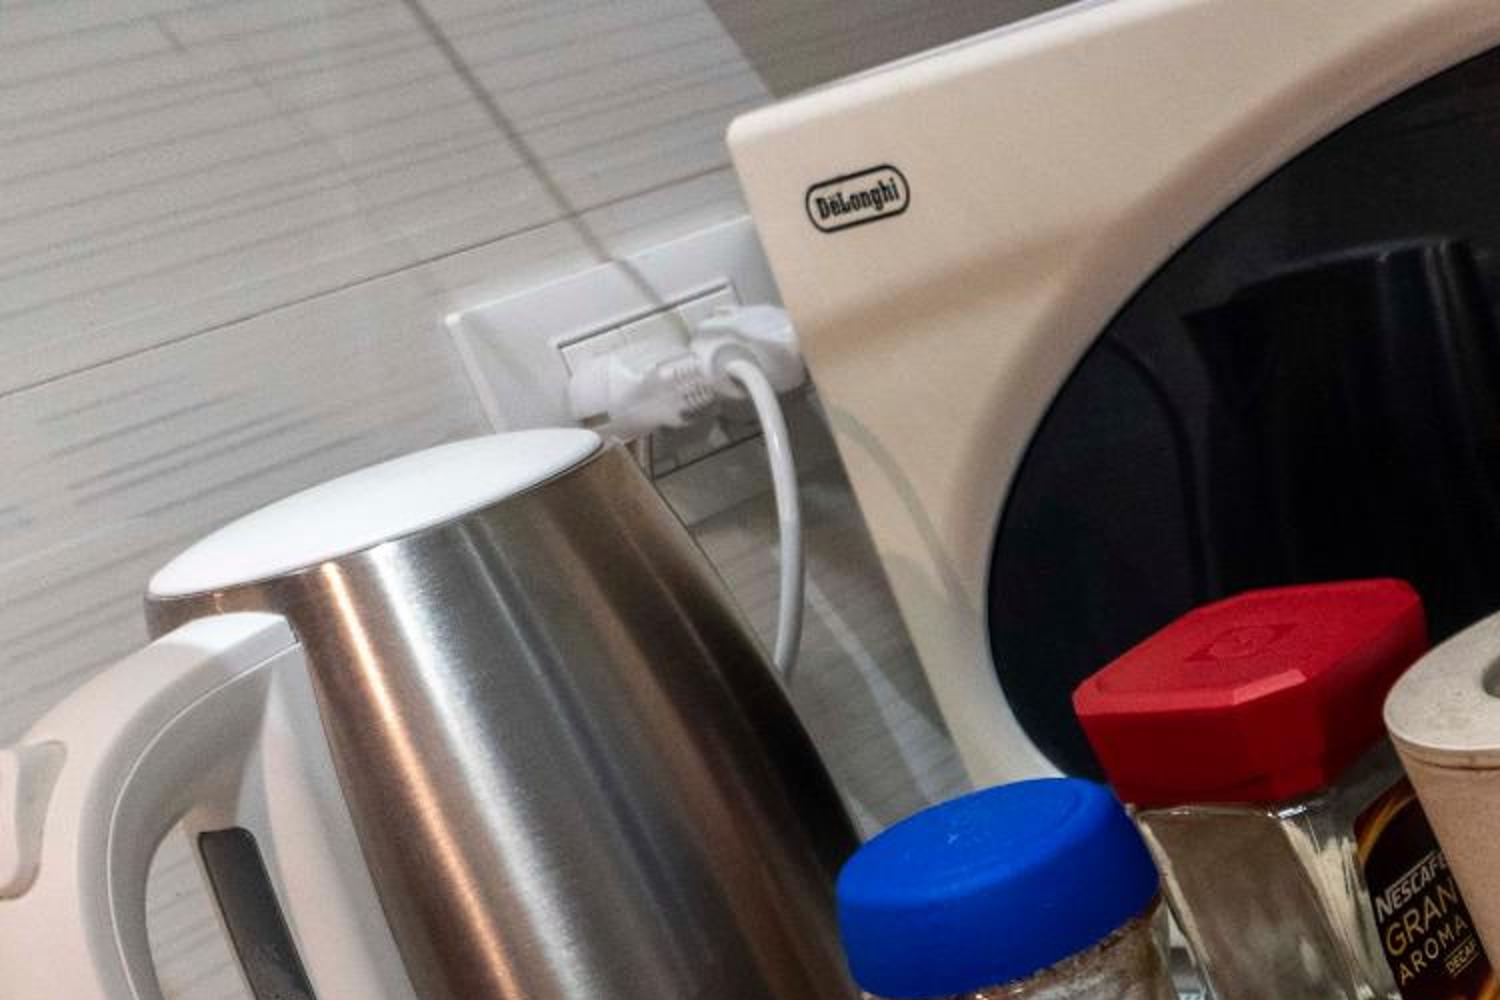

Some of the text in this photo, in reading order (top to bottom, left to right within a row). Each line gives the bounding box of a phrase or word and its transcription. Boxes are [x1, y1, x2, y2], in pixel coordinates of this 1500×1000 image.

[815, 177, 900, 220] DeLonghi
[1386, 878, 1458, 956] GRAN
[1399, 914, 1468, 986] AROMA
